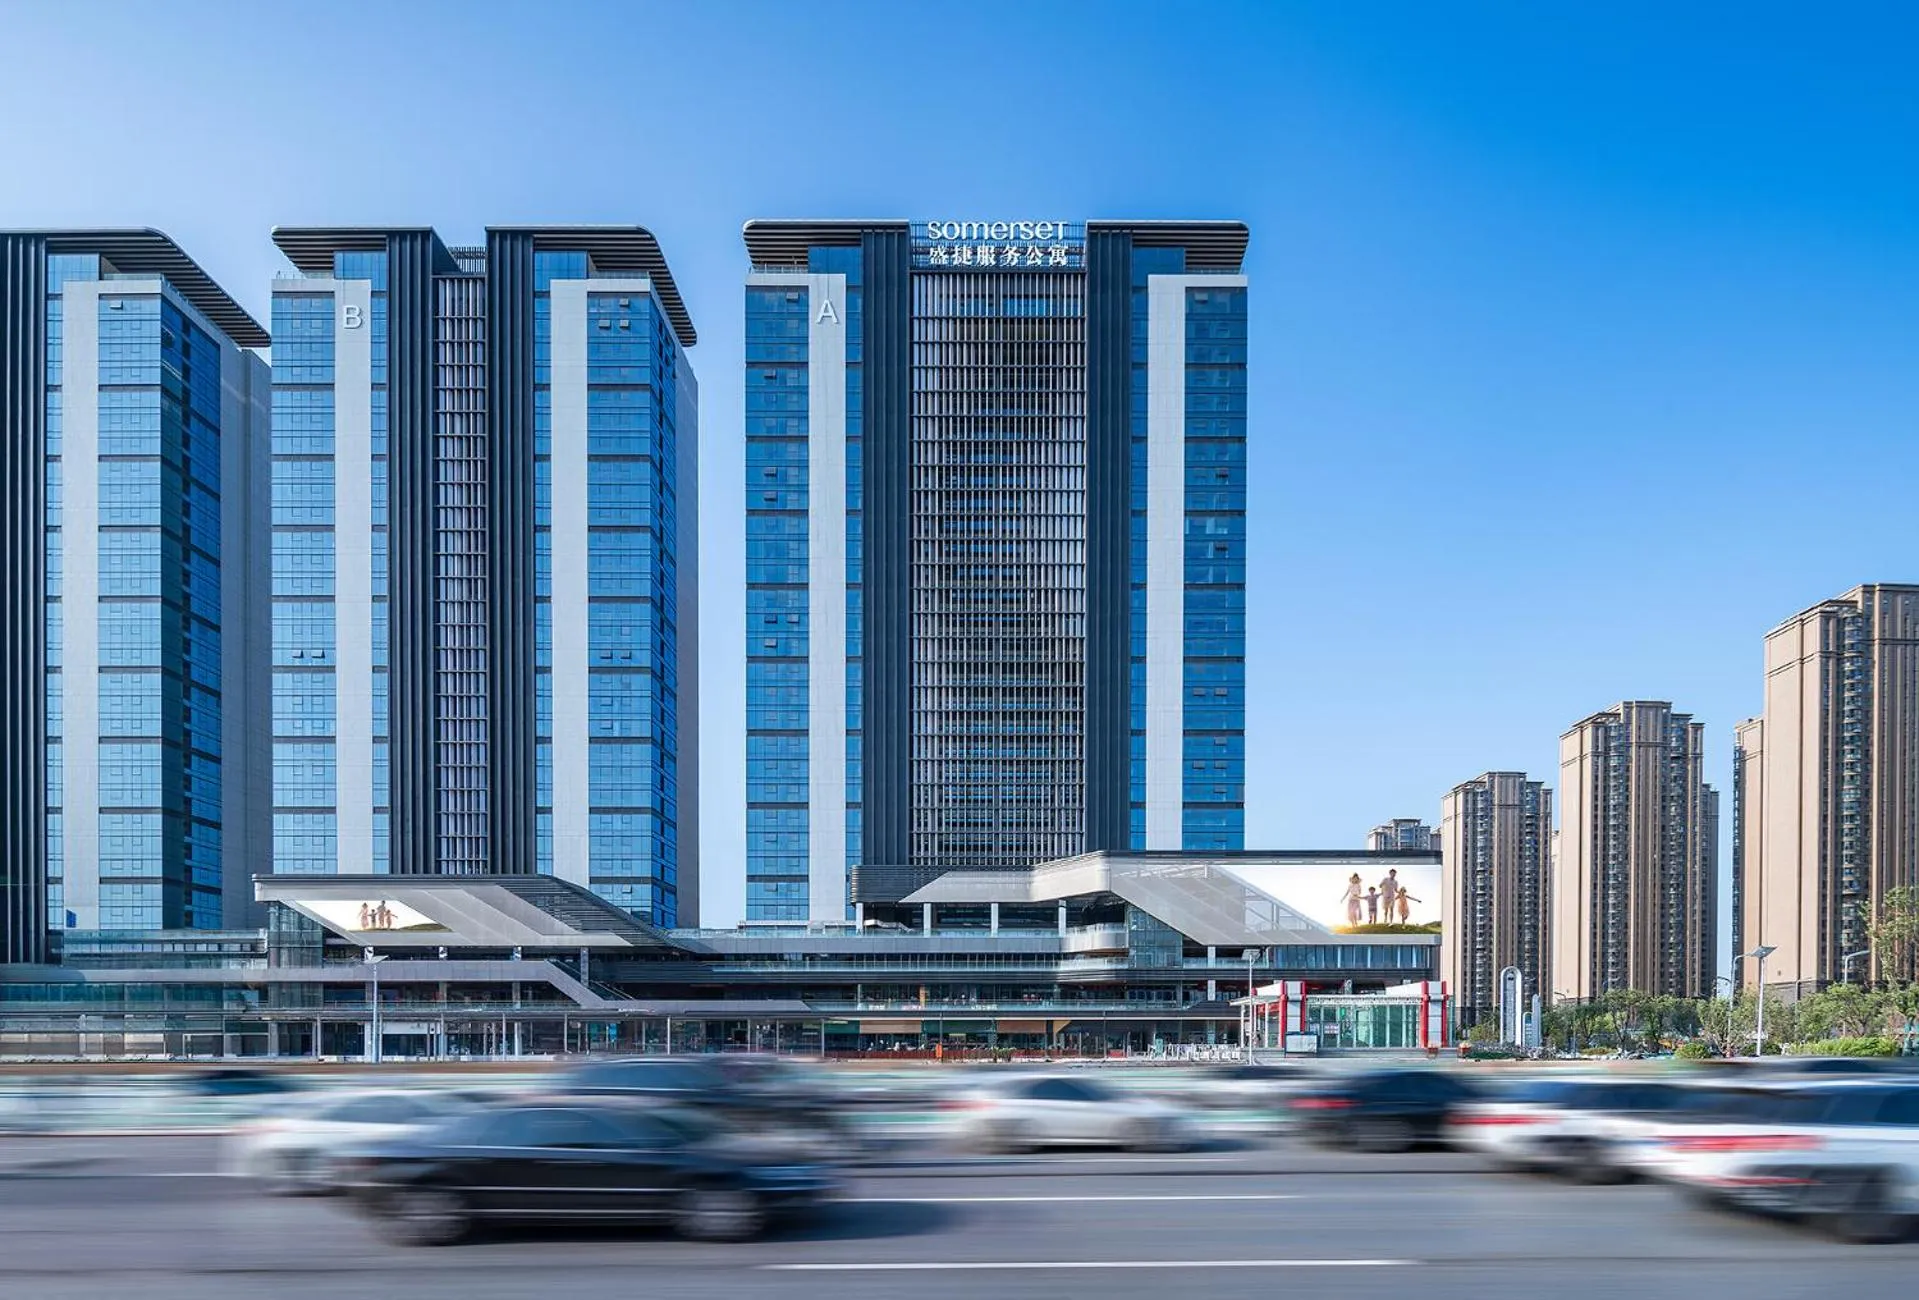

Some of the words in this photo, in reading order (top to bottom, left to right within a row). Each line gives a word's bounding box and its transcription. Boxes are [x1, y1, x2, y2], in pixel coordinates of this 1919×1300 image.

[929, 245, 1069, 266] 盛捷服务公寓
[343, 305, 362, 329] B
[816, 299, 839, 324] A
